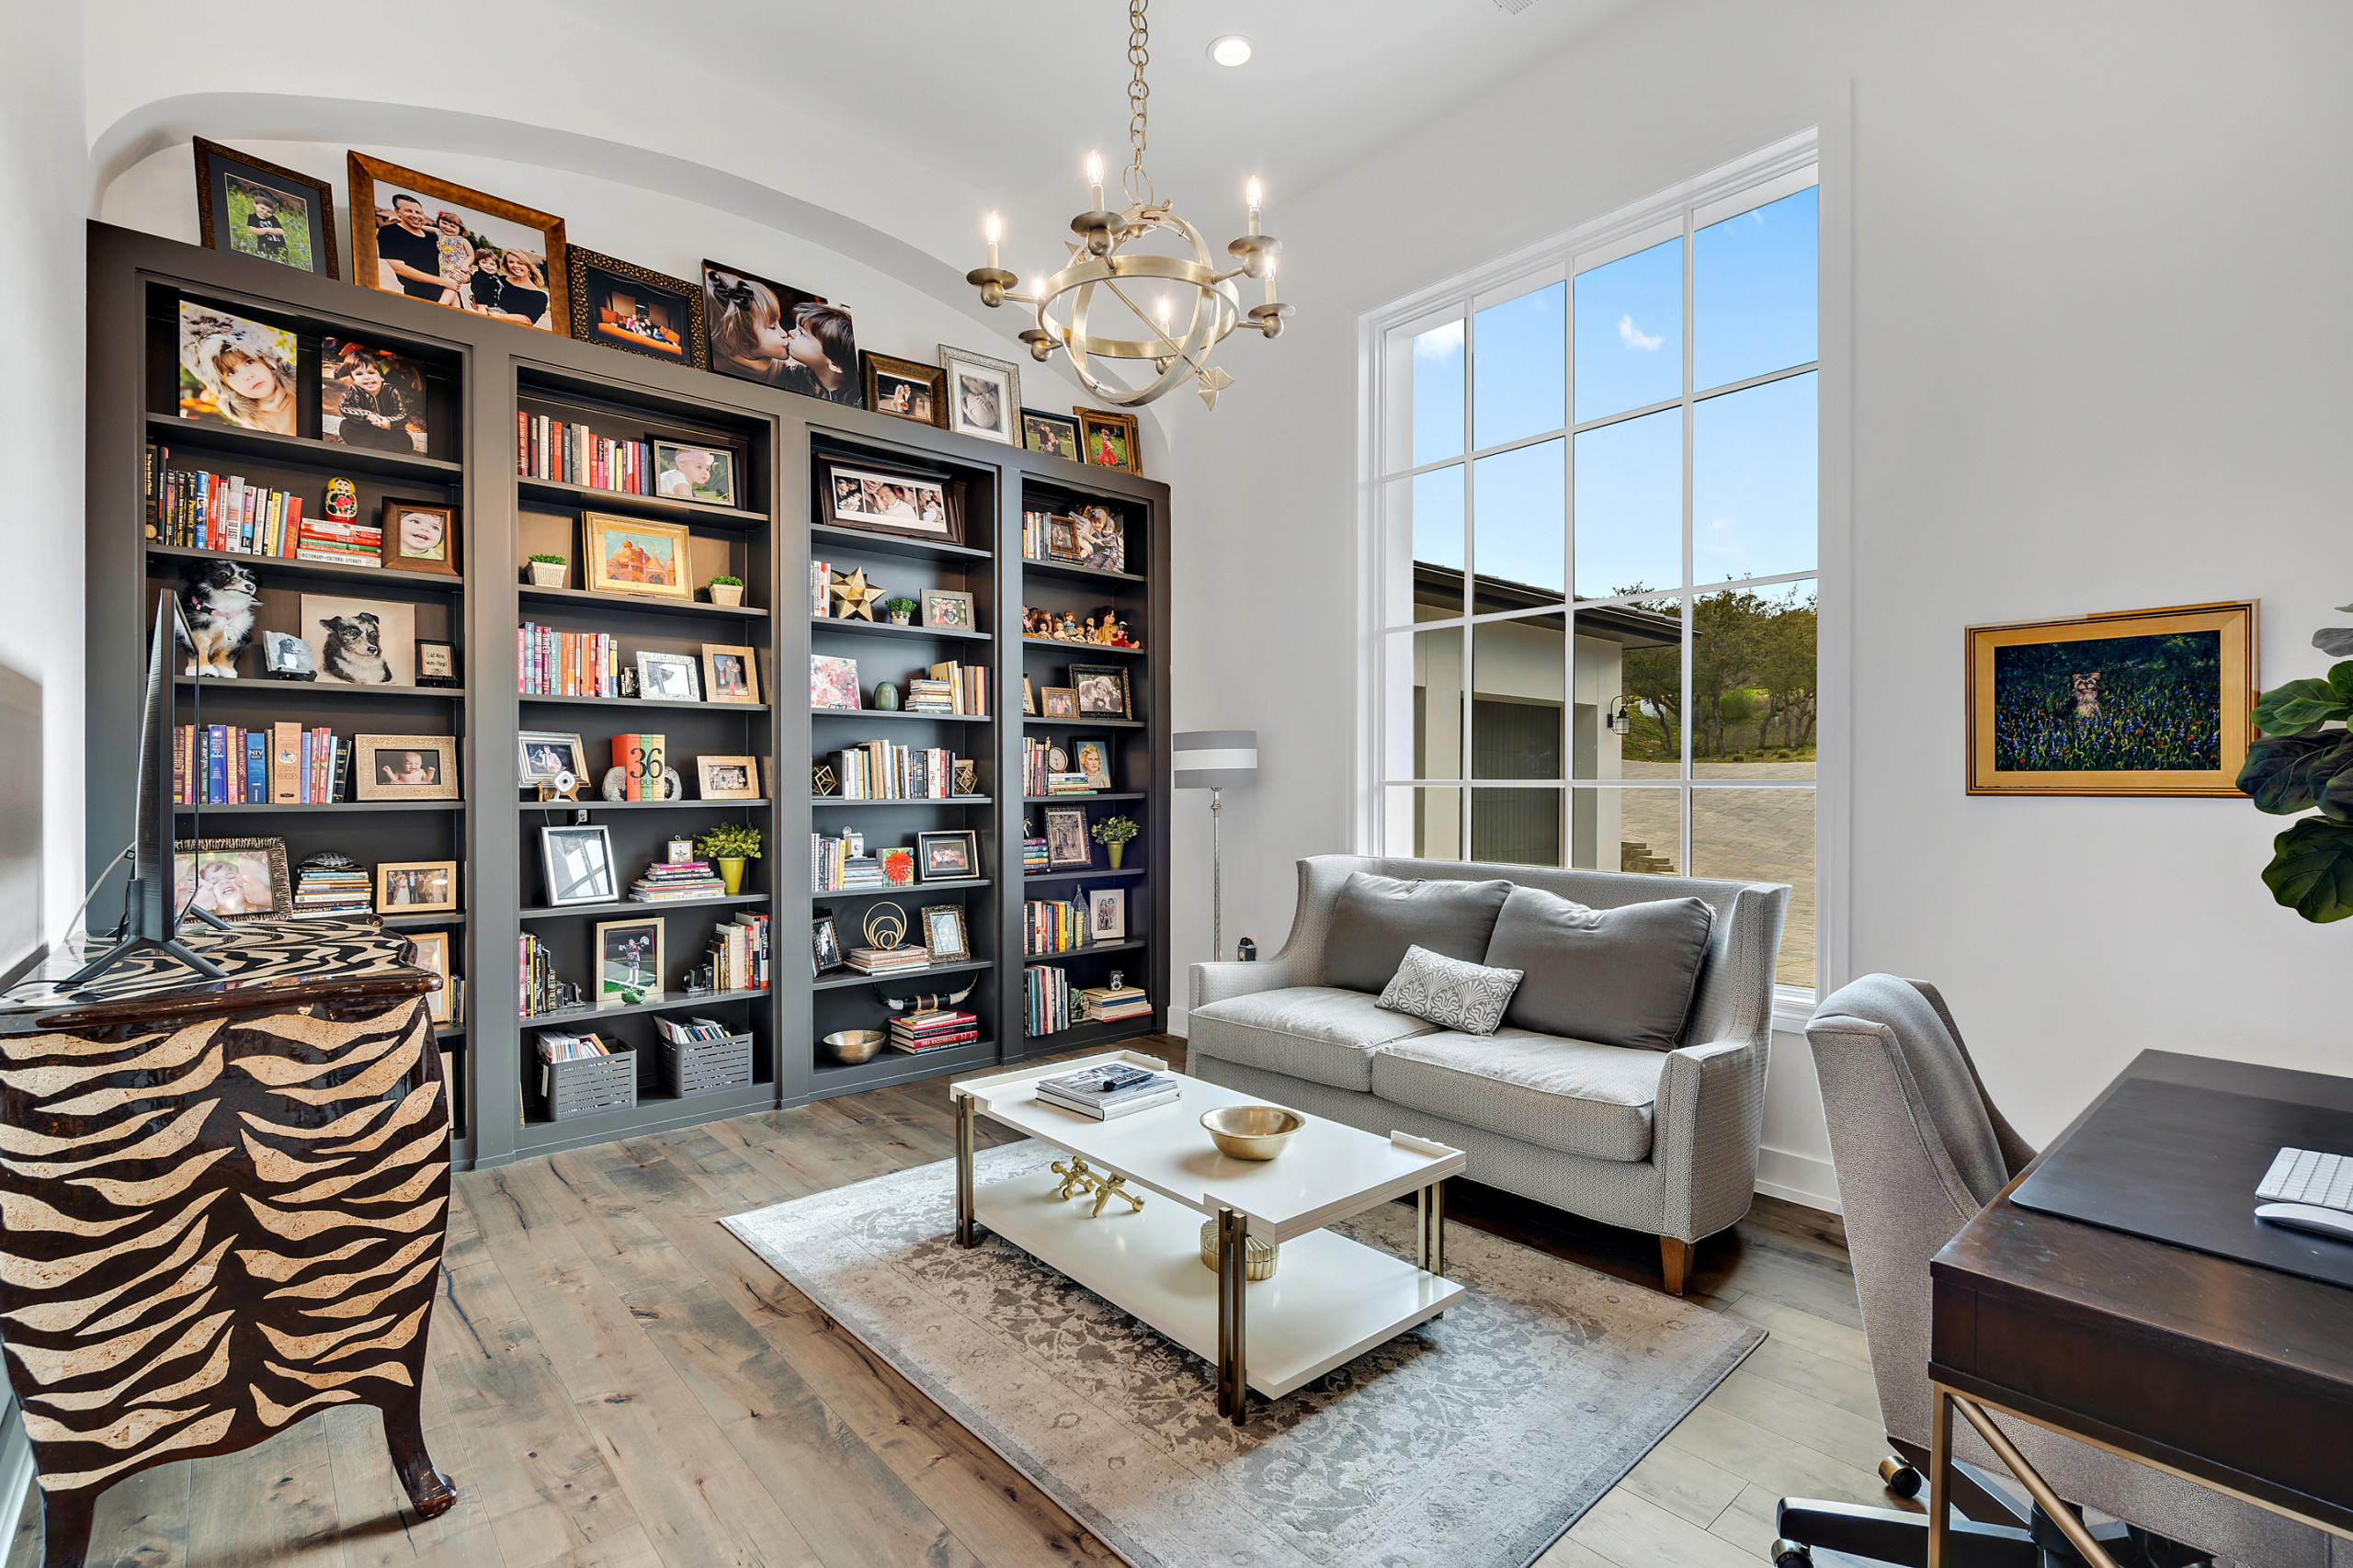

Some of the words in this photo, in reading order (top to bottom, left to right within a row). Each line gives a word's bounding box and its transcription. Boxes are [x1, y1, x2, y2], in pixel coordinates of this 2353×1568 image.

[188, 500, 196, 529] PROPHECY
[228, 528, 238, 540] LAST
[542, 633, 551, 654] SHRED
[630, 748, 664, 778] 36
